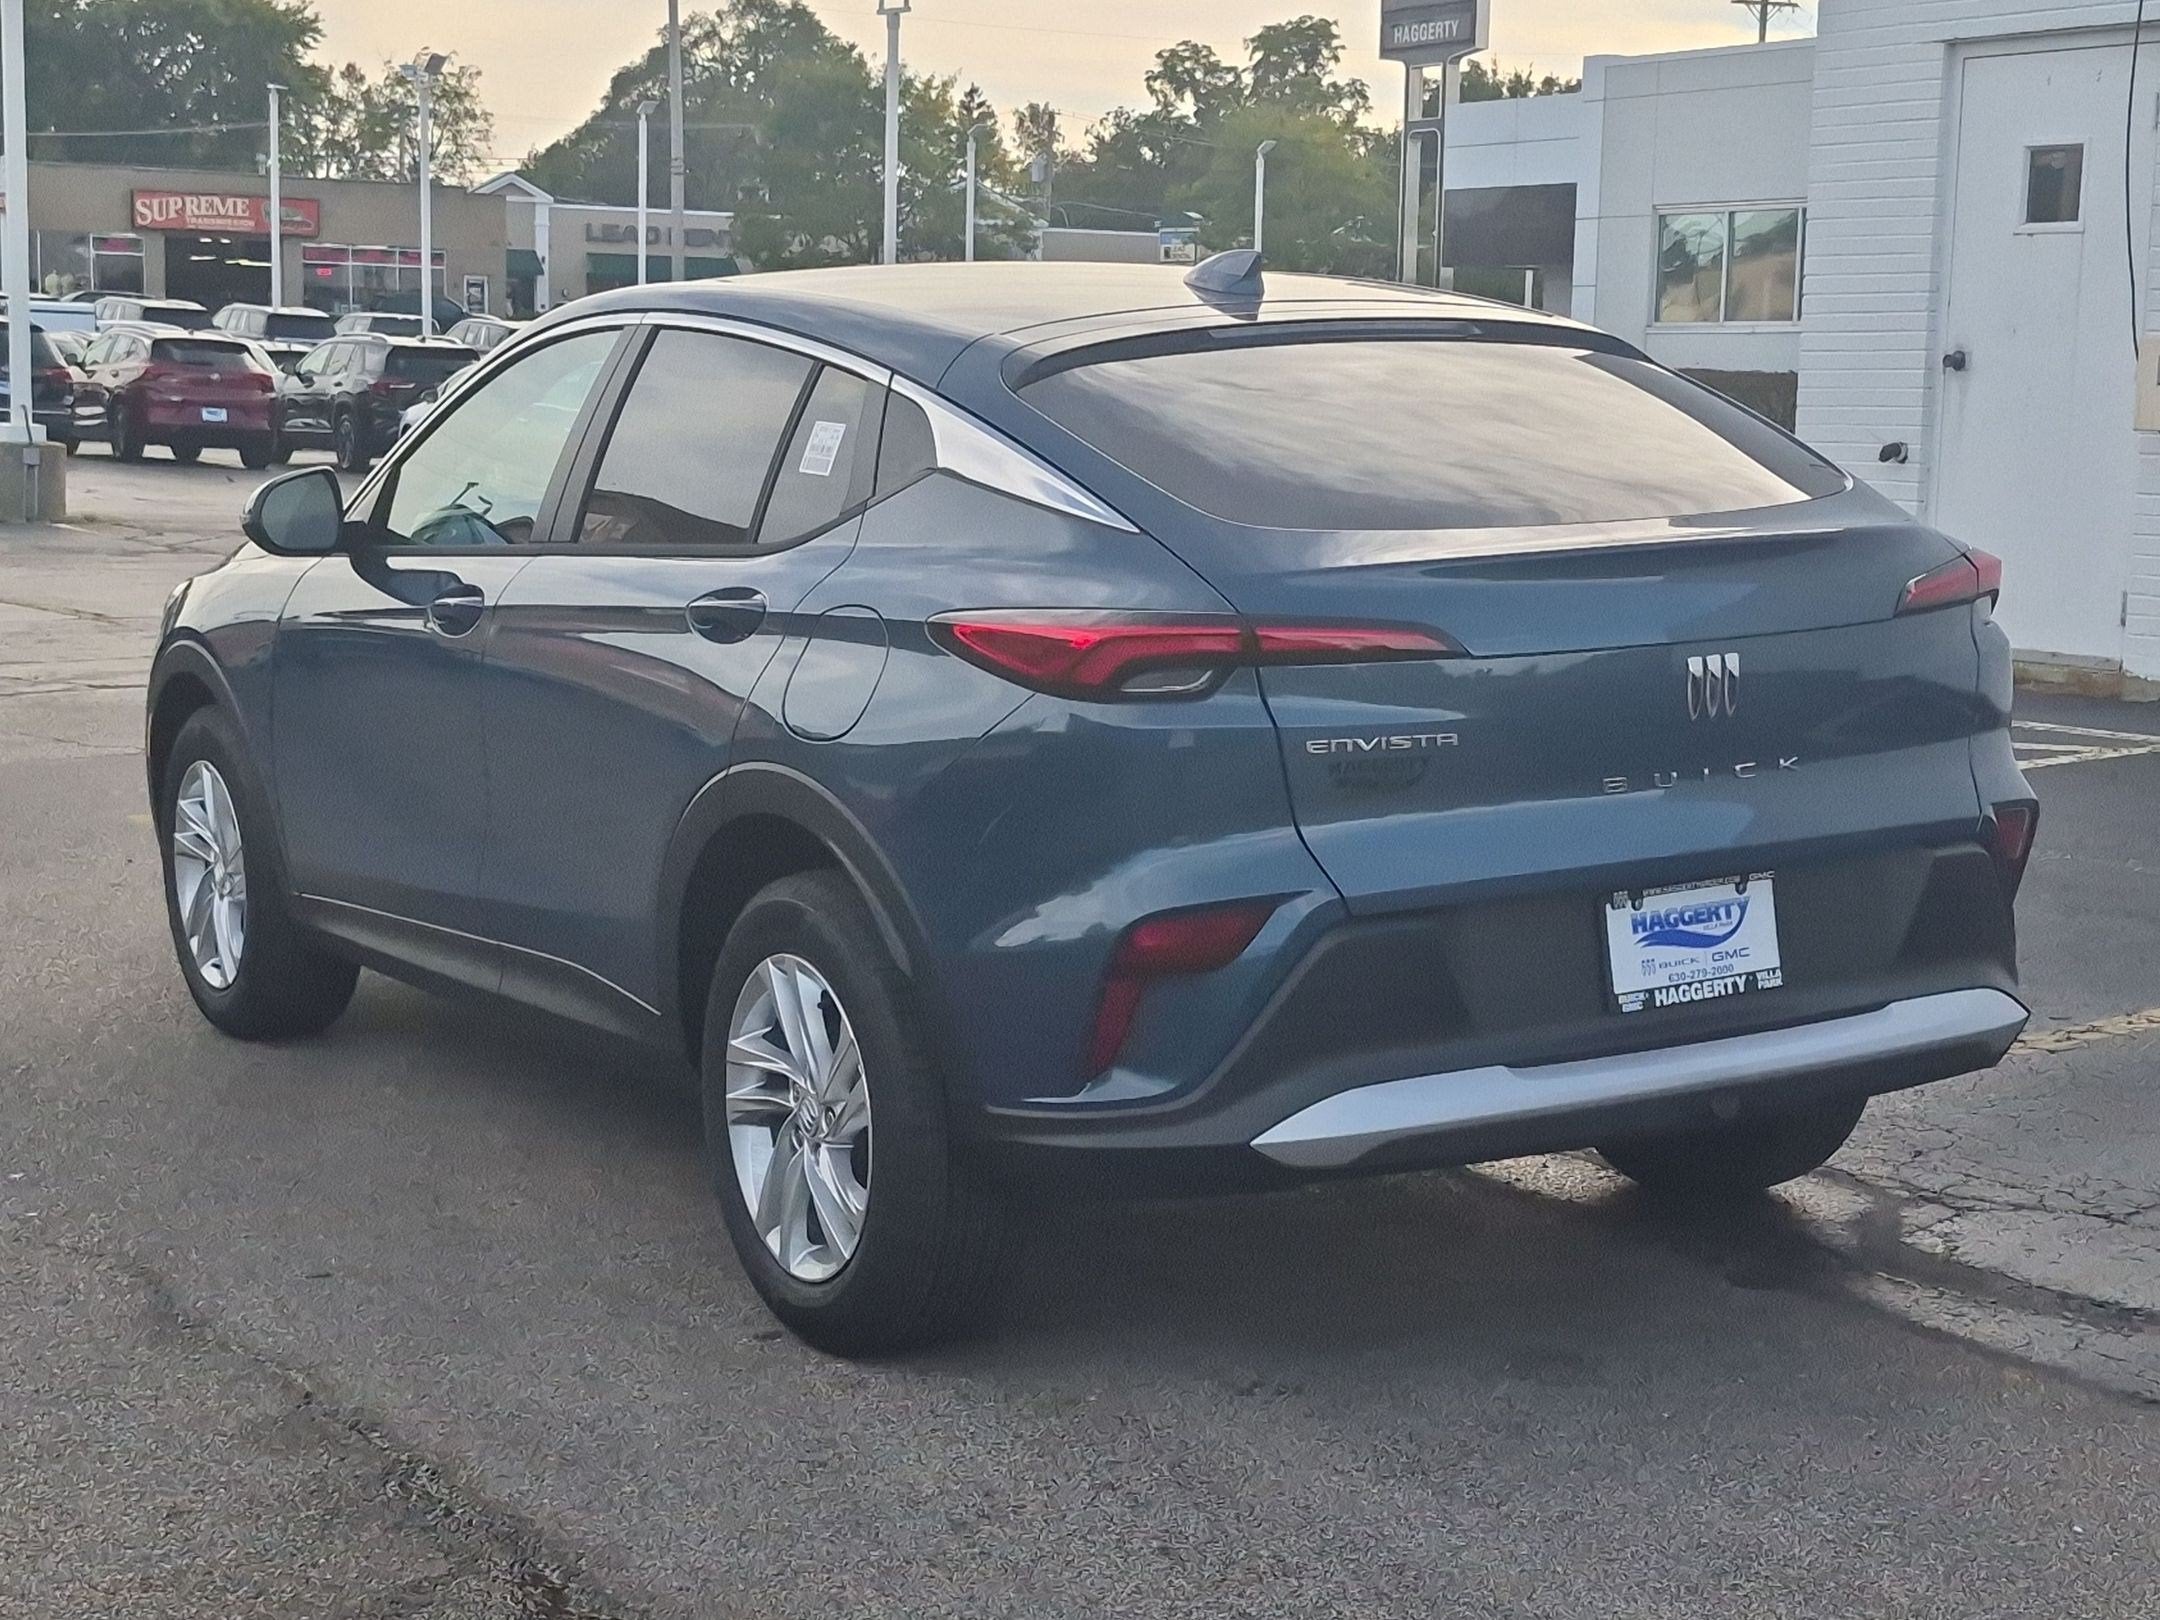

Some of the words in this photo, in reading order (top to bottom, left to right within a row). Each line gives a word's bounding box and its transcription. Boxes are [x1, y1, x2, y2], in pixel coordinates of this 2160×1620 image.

[1393, 20, 1459, 44] HAGGERTY
[135, 195, 250, 226] SUPREME
[1306, 733, 1459, 754] ENVISTA
[1602, 757, 1799, 793] BUICK
[1748, 870, 1776, 881] GMC
[1631, 895, 1752, 935] HAGGERTY
[1658, 957, 1700, 969] BUICK
[1711, 946, 1751, 962] GMC
[1668, 963, 1735, 983] 630-279-2000
[1654, 974, 1747, 1008] HAGGERTY
